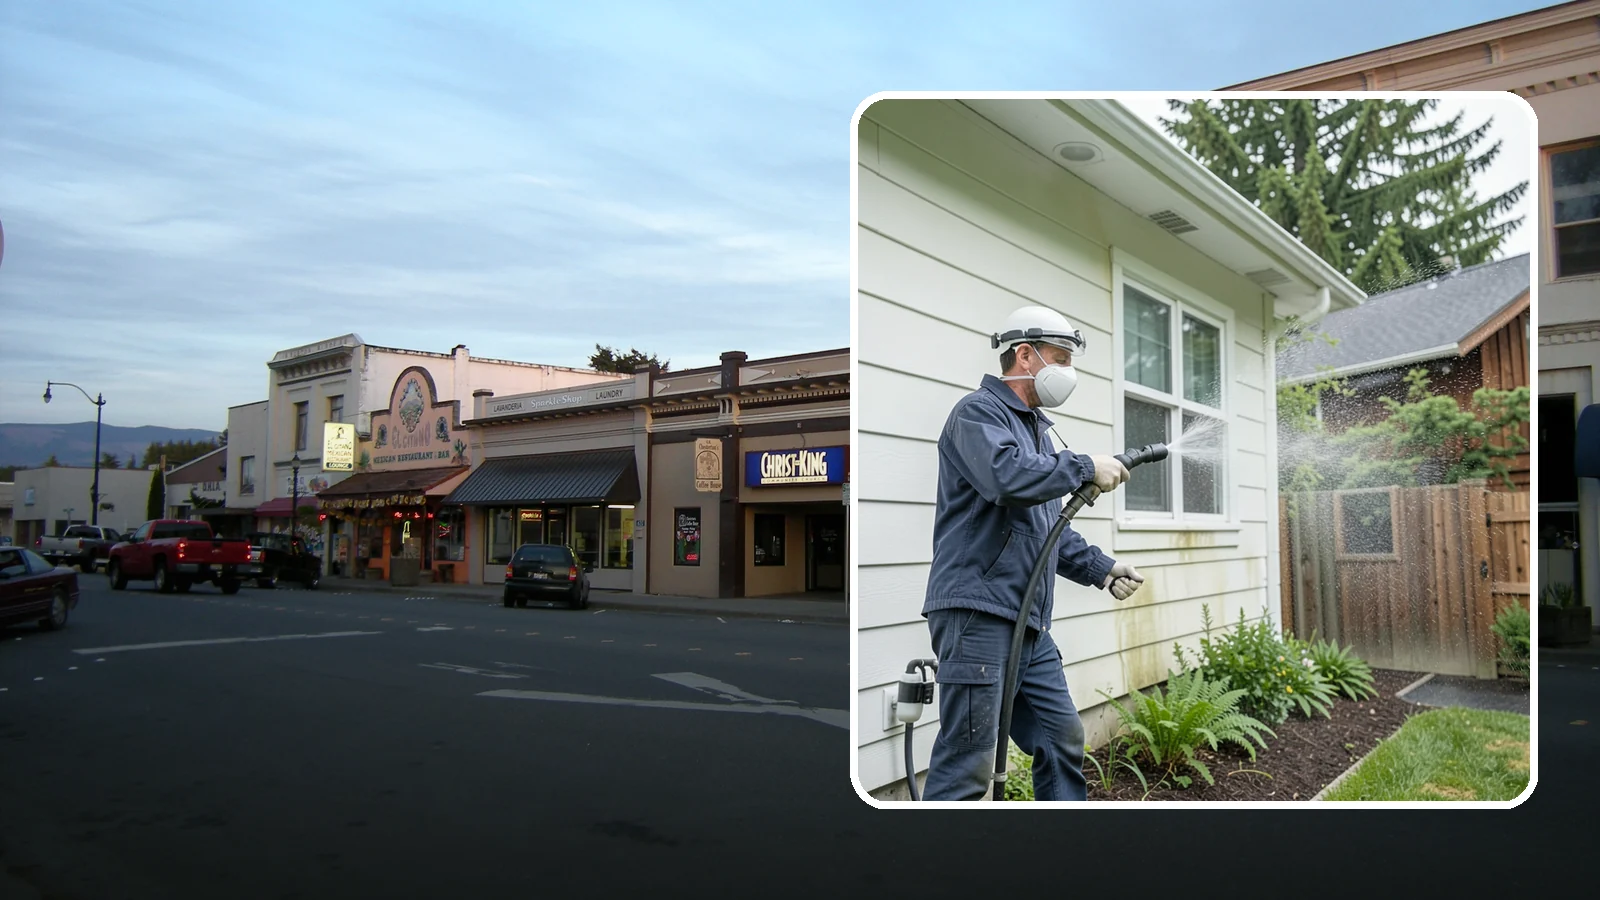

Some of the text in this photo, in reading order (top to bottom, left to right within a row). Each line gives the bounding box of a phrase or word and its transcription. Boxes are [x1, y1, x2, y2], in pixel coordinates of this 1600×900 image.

[561, 394, 583, 406] Shop
[595, 388, 624, 400] LAUNDRY
[493, 402, 523, 413] LAVANDERIA
[373, 454, 396, 464] MEXICAN
[397, 451, 433, 462] RESTAURANT
[437, 450, 450, 459] BAR
[760, 450, 827, 478] CHRIST KING
